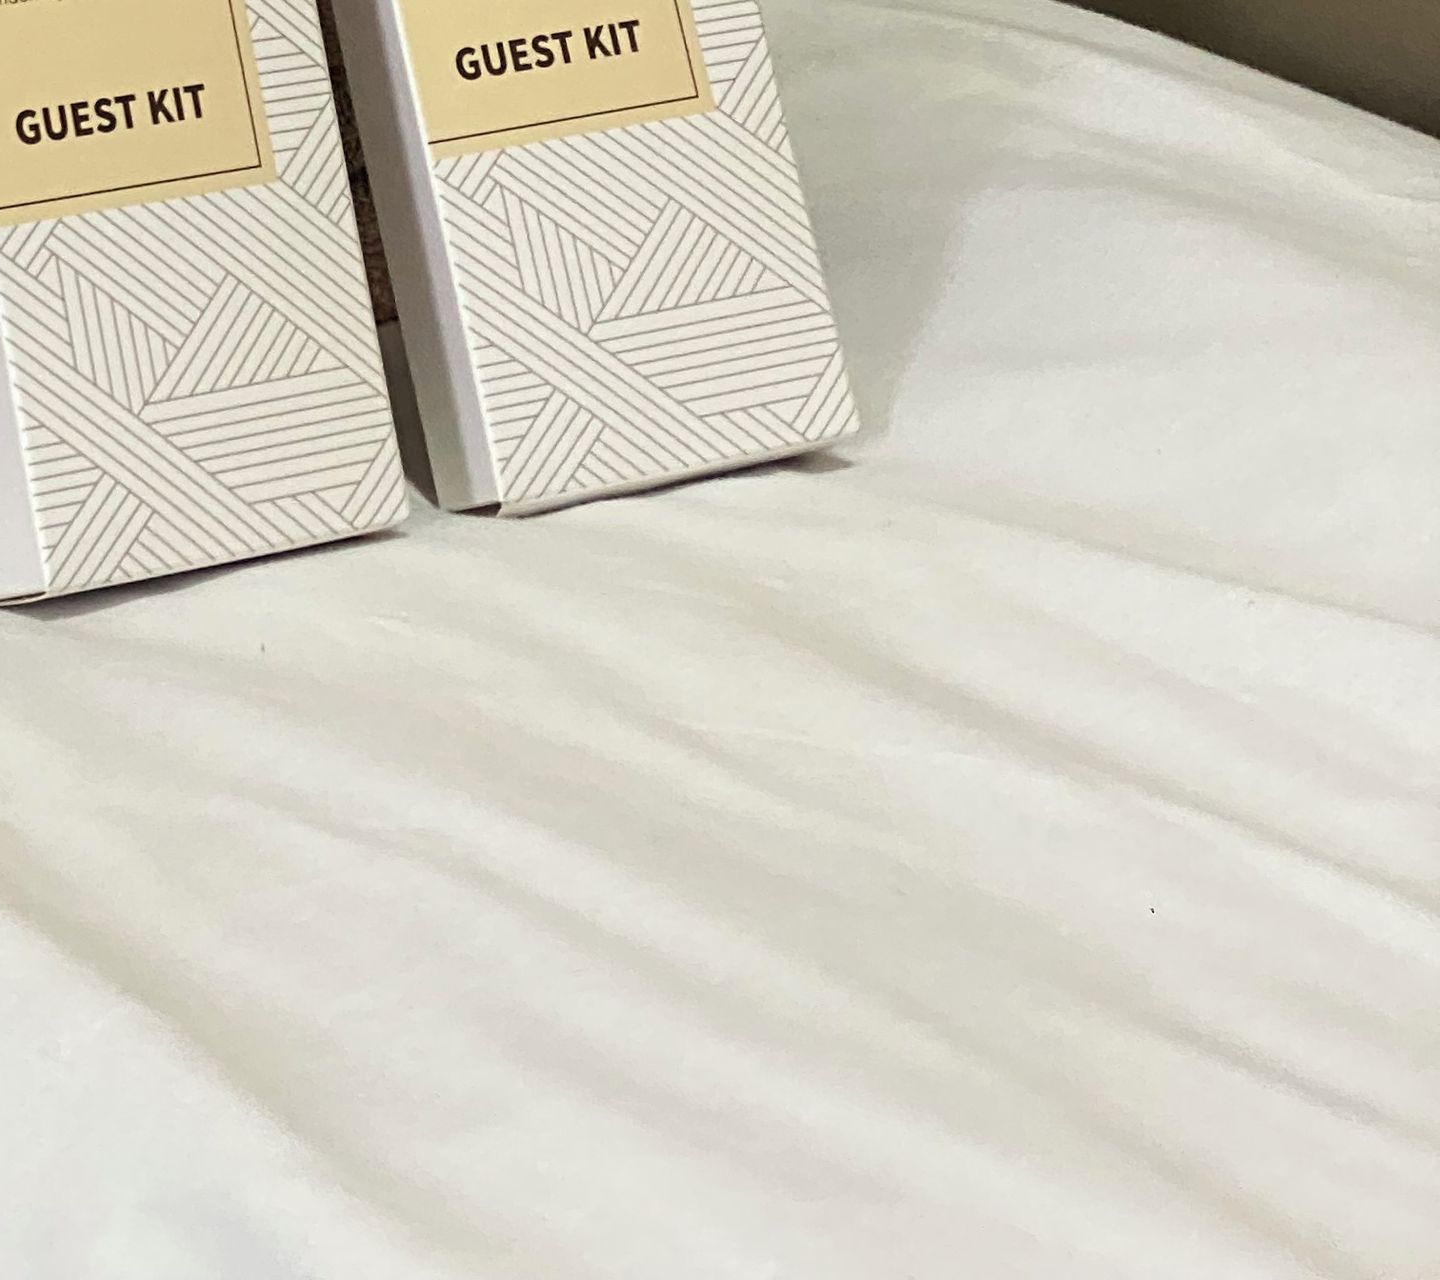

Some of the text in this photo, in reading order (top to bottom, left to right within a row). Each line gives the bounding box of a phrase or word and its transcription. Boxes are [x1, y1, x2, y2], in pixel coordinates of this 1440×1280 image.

[454, 18, 642, 82] GUEST KIT
[15, 82, 206, 146] GUEST KIT
